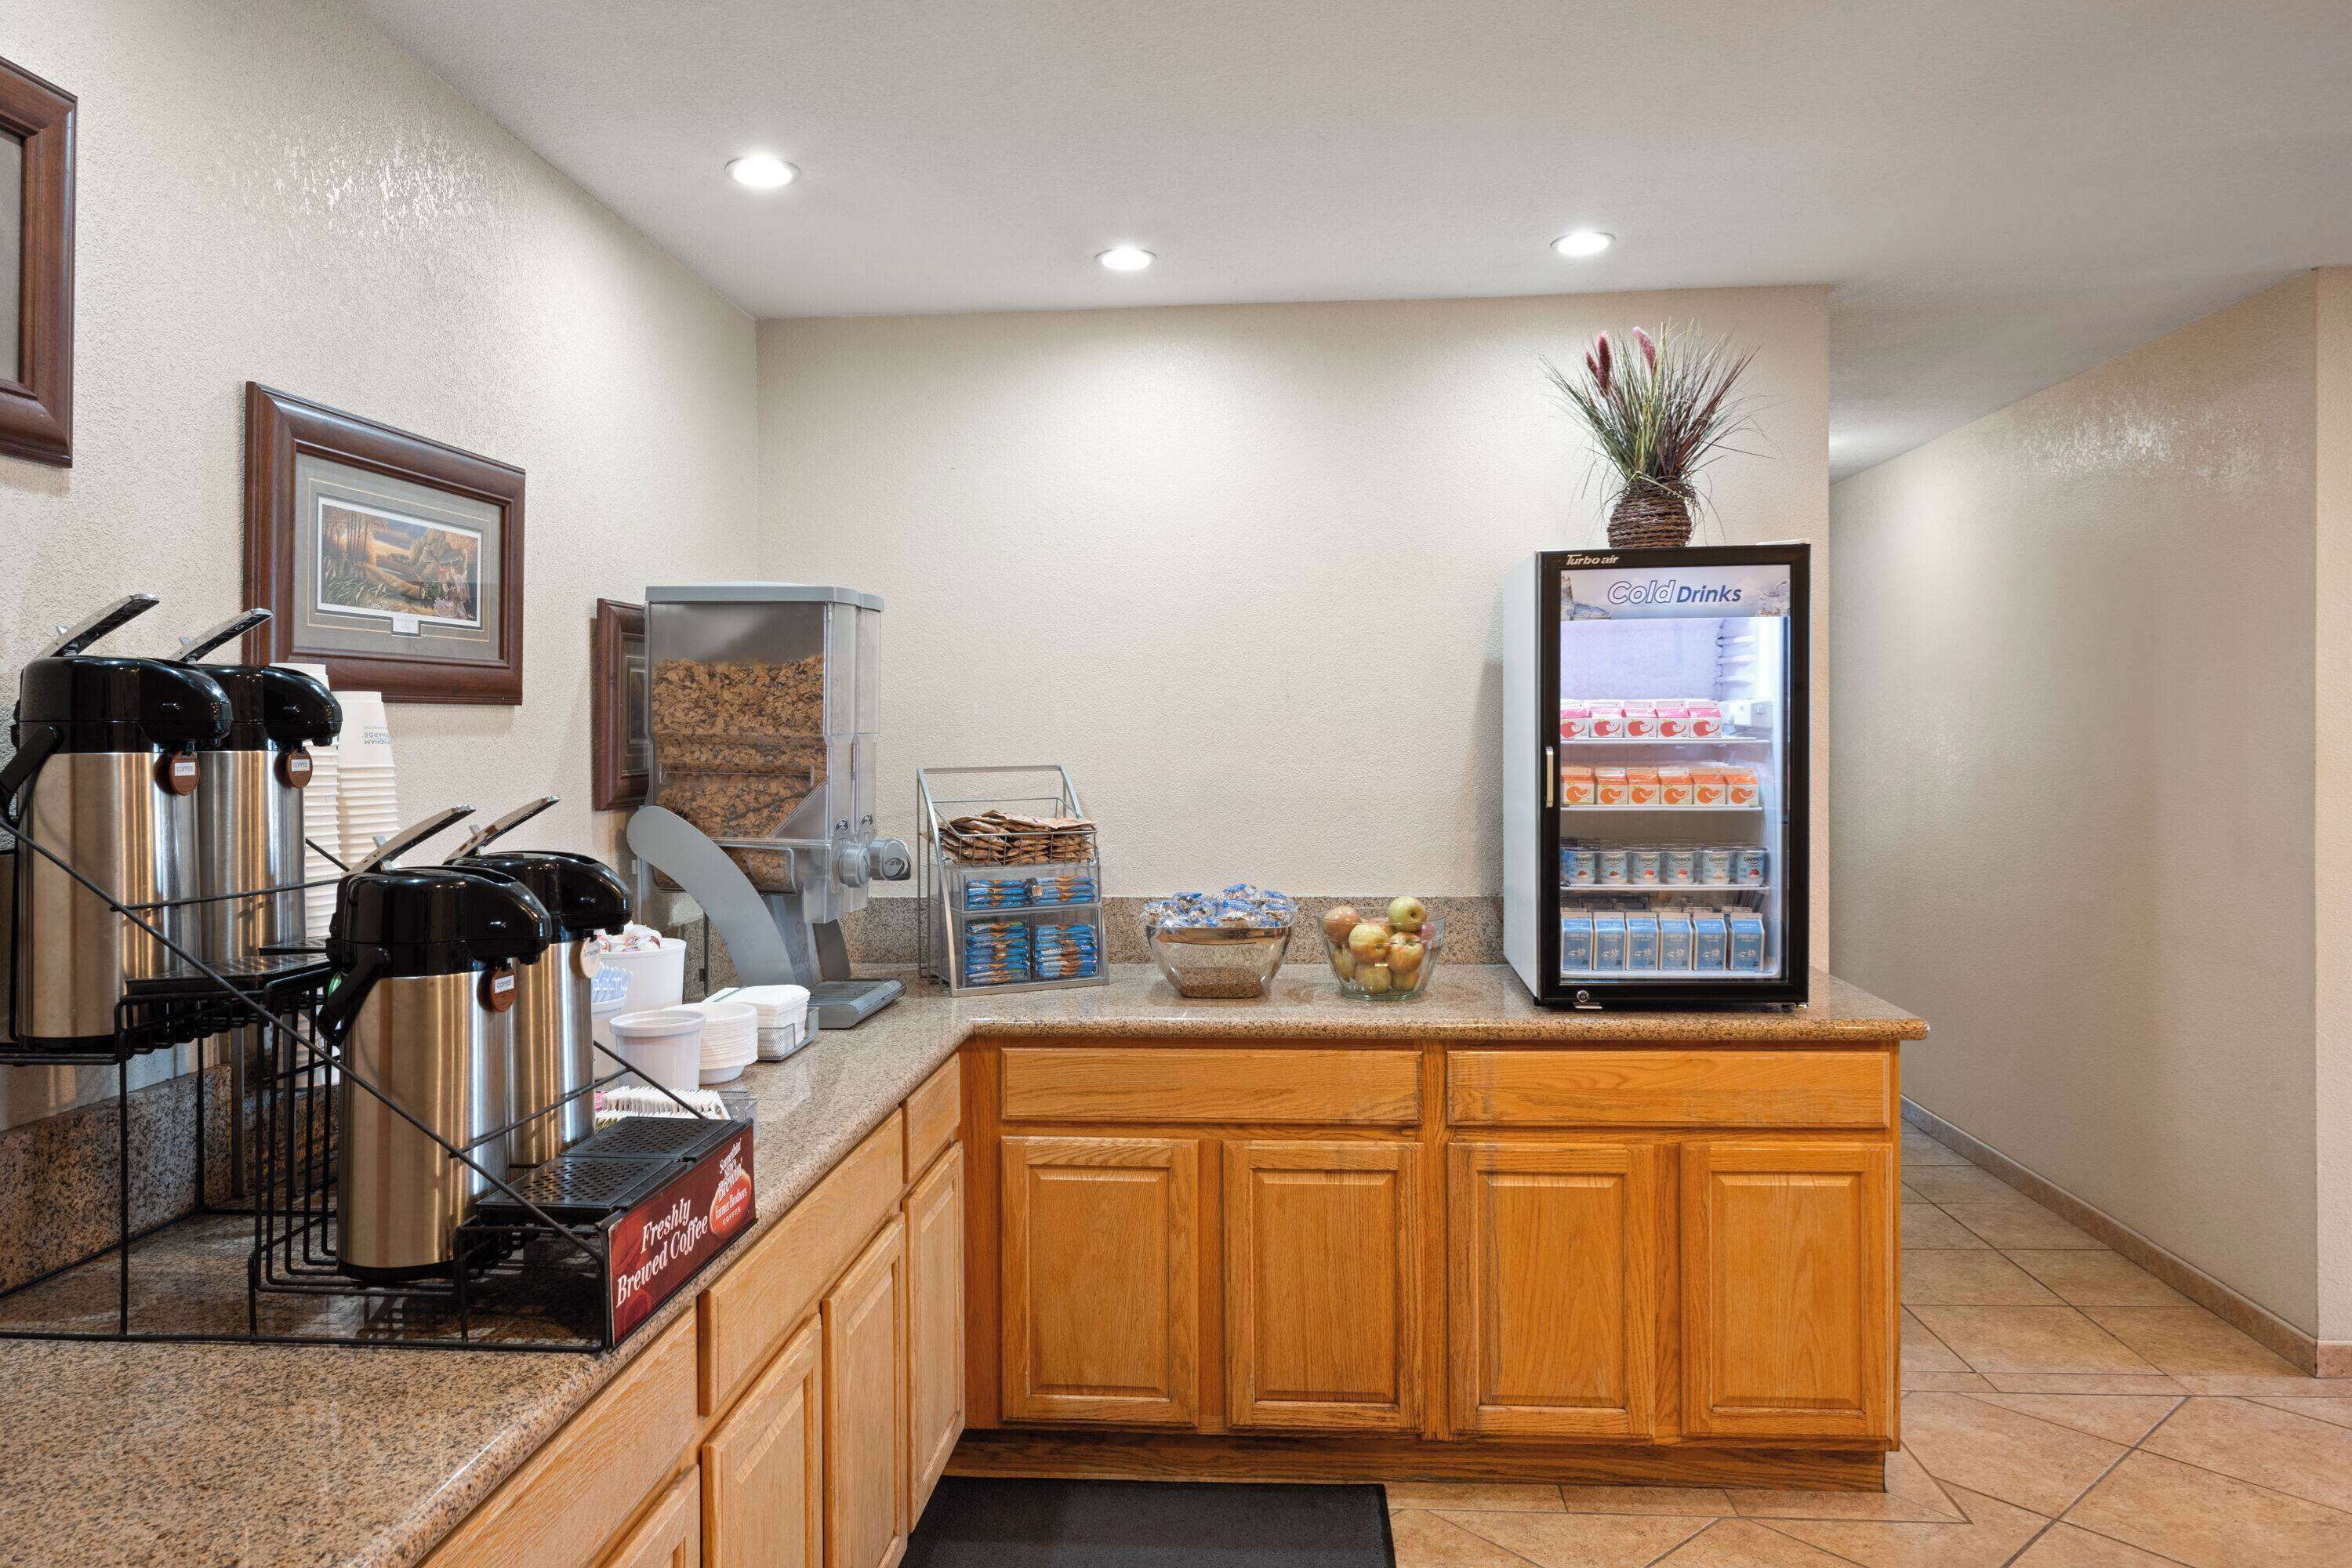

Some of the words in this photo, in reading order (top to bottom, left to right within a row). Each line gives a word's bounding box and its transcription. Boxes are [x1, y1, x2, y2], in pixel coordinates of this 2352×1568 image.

[1566, 554, 1601, 565] Turbo
[1601, 555, 1620, 564] air
[1607, 579, 1677, 604] Cold
[1676, 584, 1743, 604] Drinks
[729, 1187, 747, 1208] Brothers
[641, 1198, 691, 1254] Freshly
[723, 1206, 741, 1225] COFFEE
[616, 1240, 668, 1308] Brewed
[670, 1215, 709, 1260] Coffee
